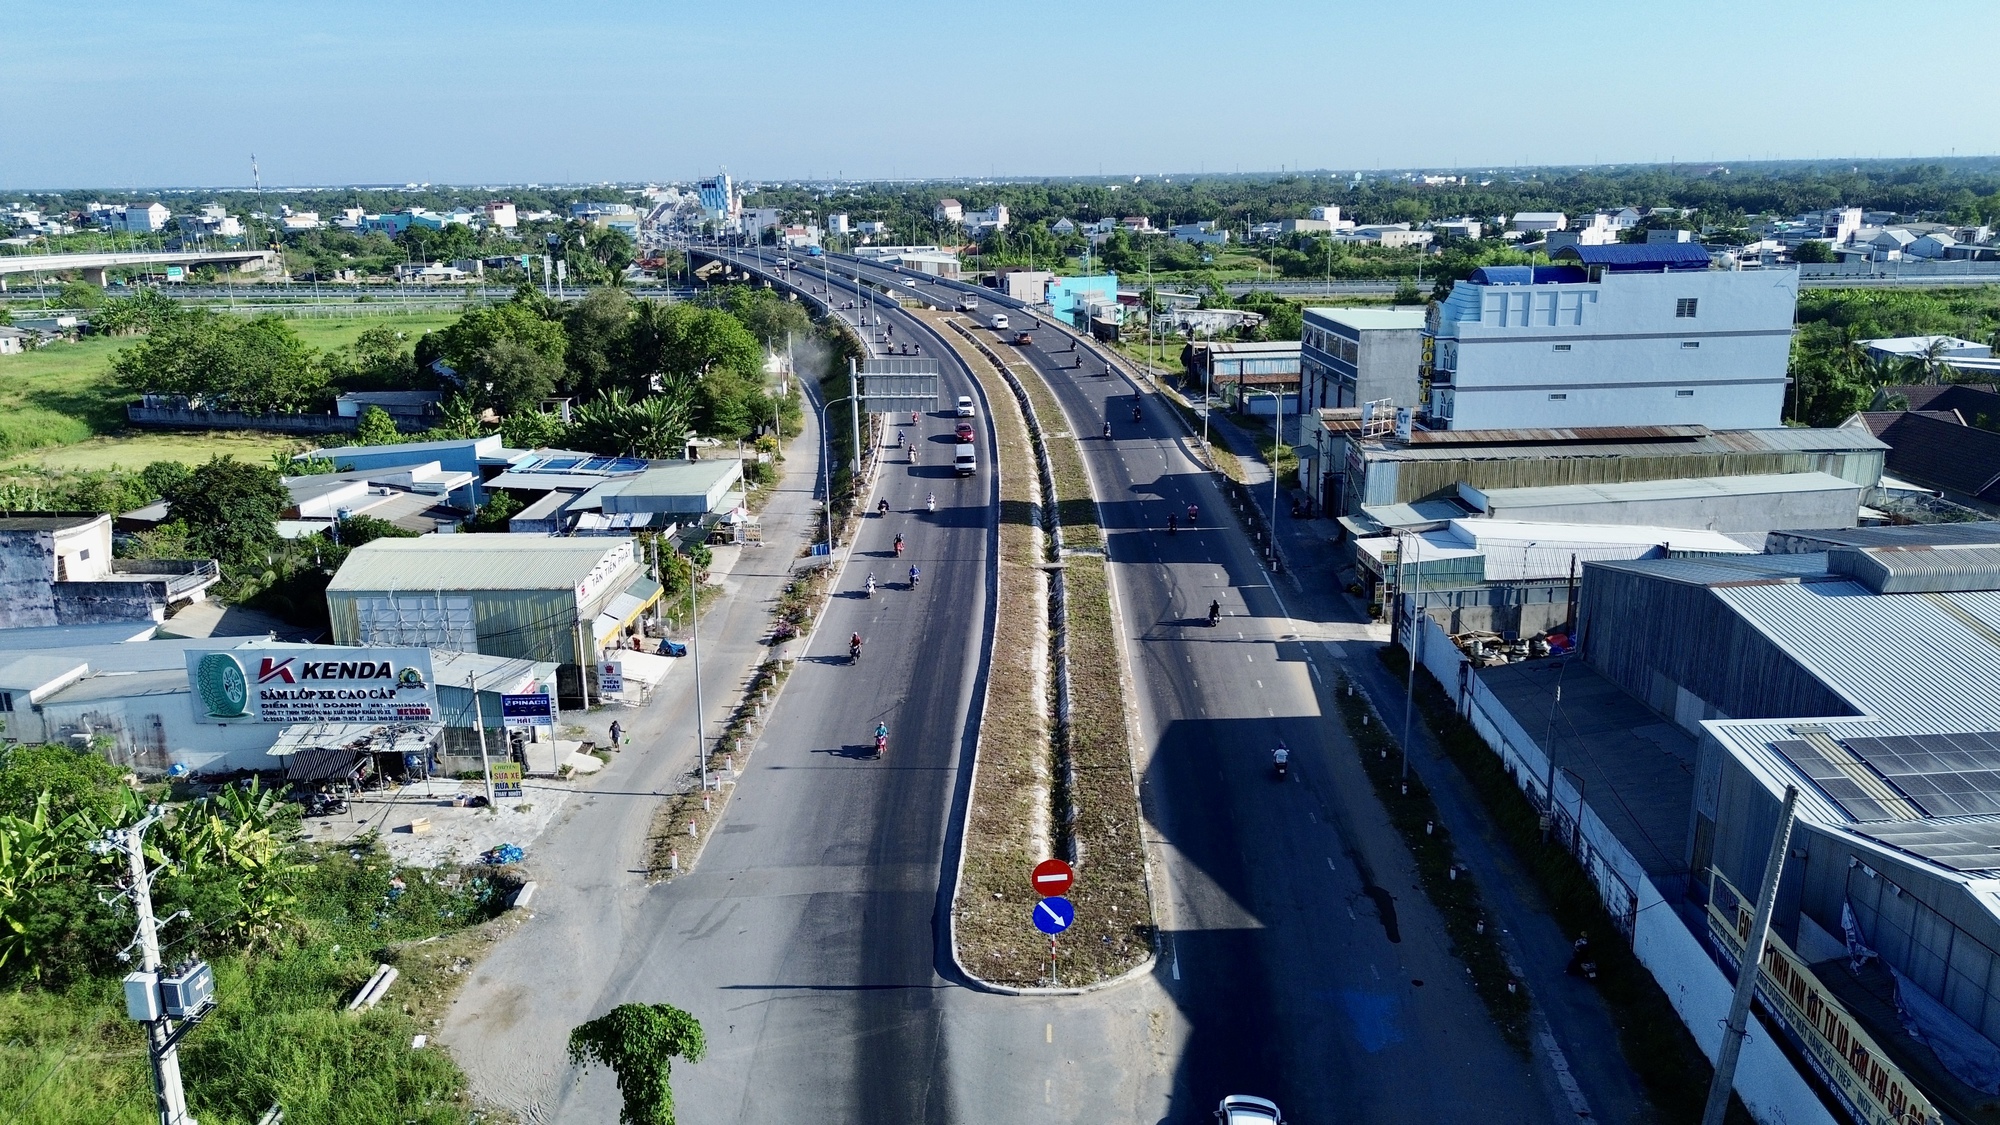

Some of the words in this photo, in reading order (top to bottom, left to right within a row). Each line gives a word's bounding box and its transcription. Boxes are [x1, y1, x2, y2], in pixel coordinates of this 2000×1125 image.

[1421, 336, 1434, 405] HOTEL
[302, 661, 392, 680] KENDA
[318, 690, 336, 700] XE
[337, 690, 367, 700] CAO
[1856, 1090, 1872, 1119] INOX
